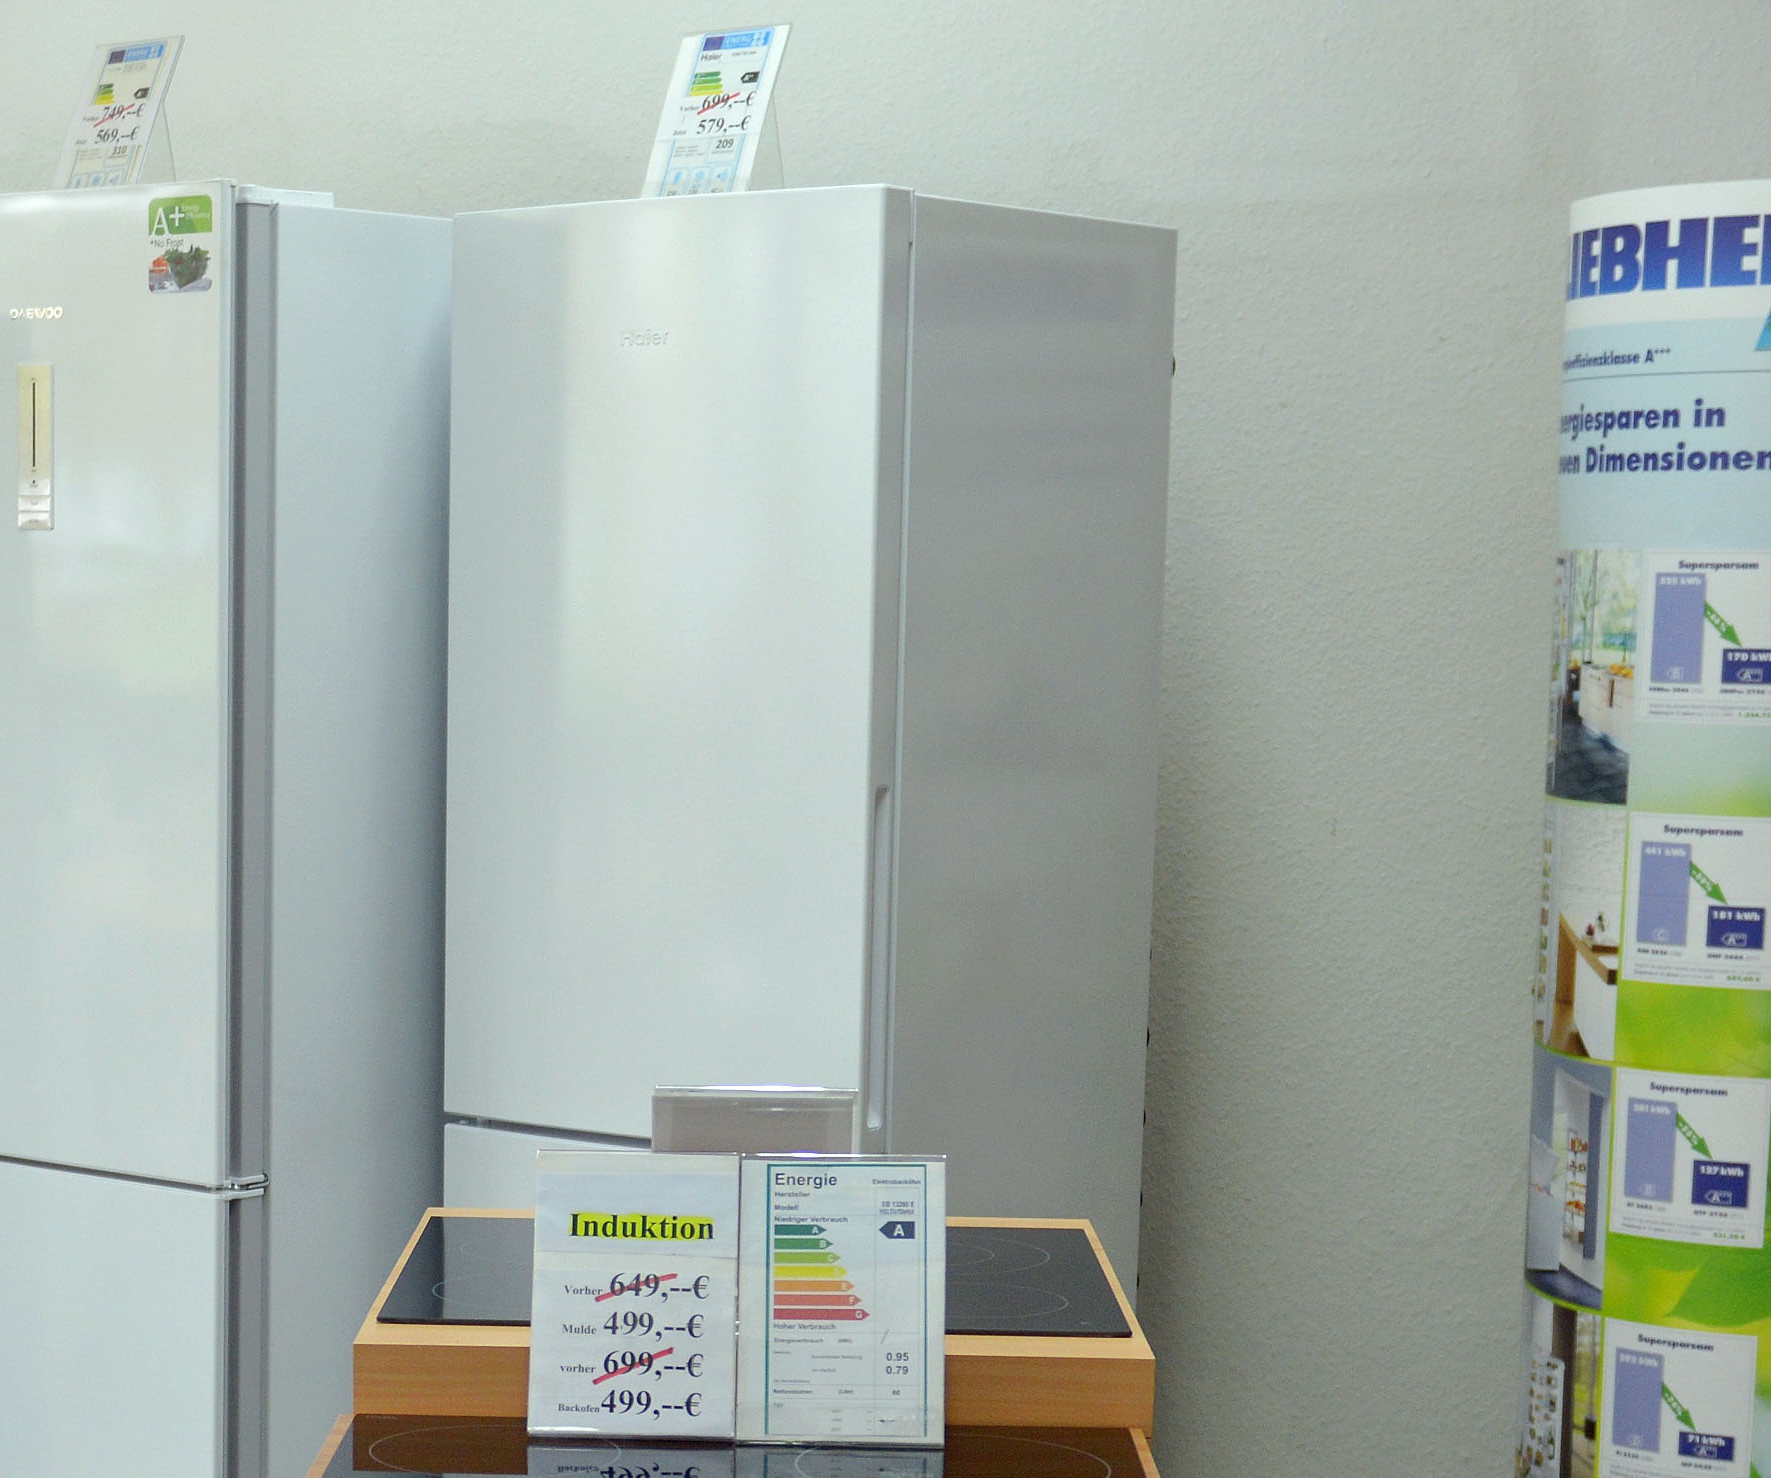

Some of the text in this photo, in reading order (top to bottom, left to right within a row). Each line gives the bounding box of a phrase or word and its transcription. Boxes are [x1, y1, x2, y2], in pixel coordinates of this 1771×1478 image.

[697, 115, 751, 135] 579,--€
[715, 138, 734, 149] 209
[148, 206, 185, 236] A+
[1693, 398, 1726, 428] in
[1678, 560, 1759, 571] Supersparsam
[1664, 824, 1743, 837] Supersparsam
[1736, 911, 1760, 922] kWh
[1650, 1082, 1728, 1097] Supersparsam
[1720, 1166, 1744, 1177] kWh
[774, 1173, 838, 1190] Energie
[774, 1190, 811, 1198] Hersteller
[774, 1215, 849, 1224] Niedriger Verbrauch
[569, 1213, 714, 1241] Induktion
[811, 1223, 905, 1237] A A
[819, 1240, 827, 1248] B
[564, 1272, 710, 1304] Vorher 649,--€
[855, 1310, 863, 1319] G
[562, 1311, 705, 1343] Mulde 499,--€
[1638, 1334, 1714, 1351] Supersparsam
[886, 1352, 909, 1362] 0.95
[560, 1350, 704, 1382] vorher 699,--€
[885, 1365, 909, 1375] 0.79
[558, 1389, 704, 1421] Backofen 499,--€
[1701, 1435, 1725, 1446] kWh
